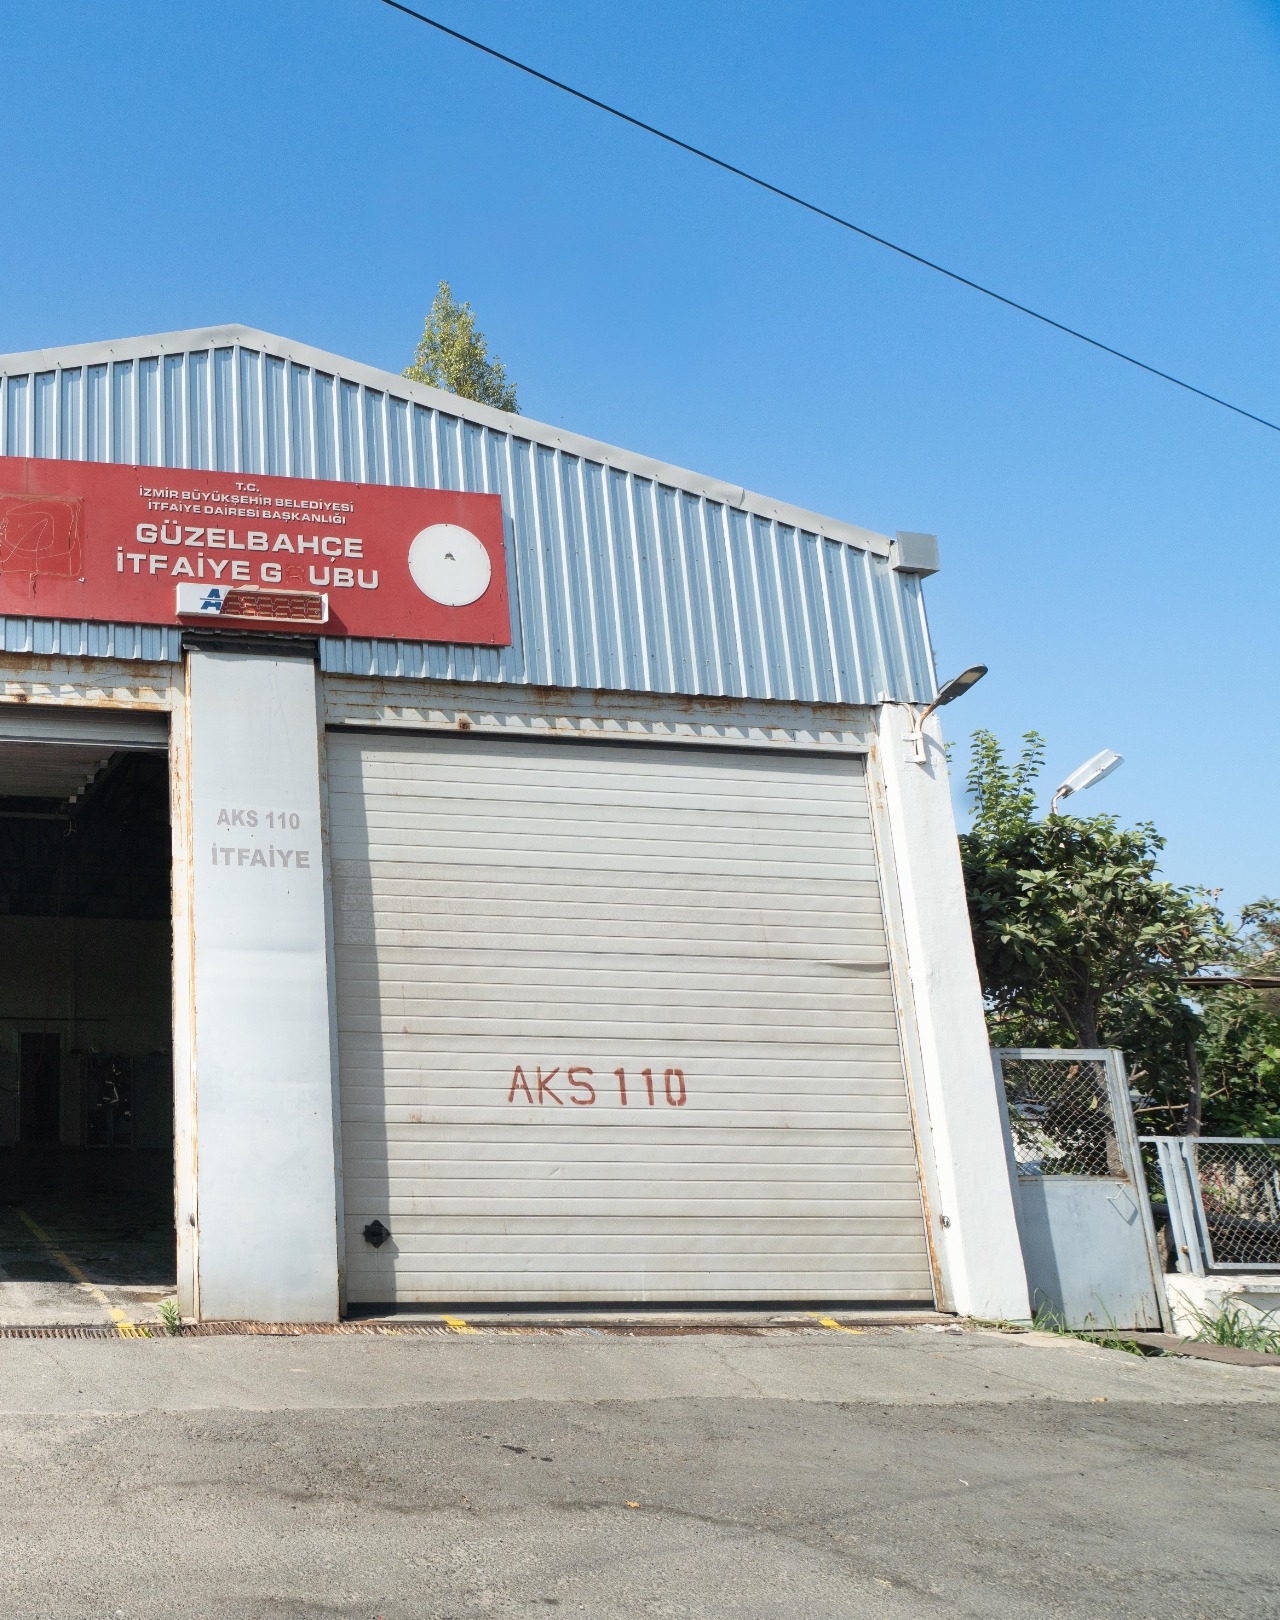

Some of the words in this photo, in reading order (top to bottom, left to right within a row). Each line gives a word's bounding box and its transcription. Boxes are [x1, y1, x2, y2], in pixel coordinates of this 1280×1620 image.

[139, 485, 179, 500] İZMİR
[181, 489, 272, 507] BÜYÜKŞEHİR
[275, 498, 354, 513] BELEDİYESİ
[235, 482, 260, 492] T.C.
[148, 499, 202, 515] İTFAİYE
[204, 505, 260, 519] DAİRESİ
[262, 510, 346, 525] BAŞKANLIĞI
[136, 519, 364, 562] GÜZELBAHÇE
[117, 546, 251, 581] İTFAİYE
[260, 562, 379, 589] GUBU
[217, 808, 259, 828] AKS
[265, 811, 300, 830] 110
[211, 842, 311, 869] İTFAİYE
[508, 1065, 596, 1106] AKS
[614, 1067, 687, 1106] 110
